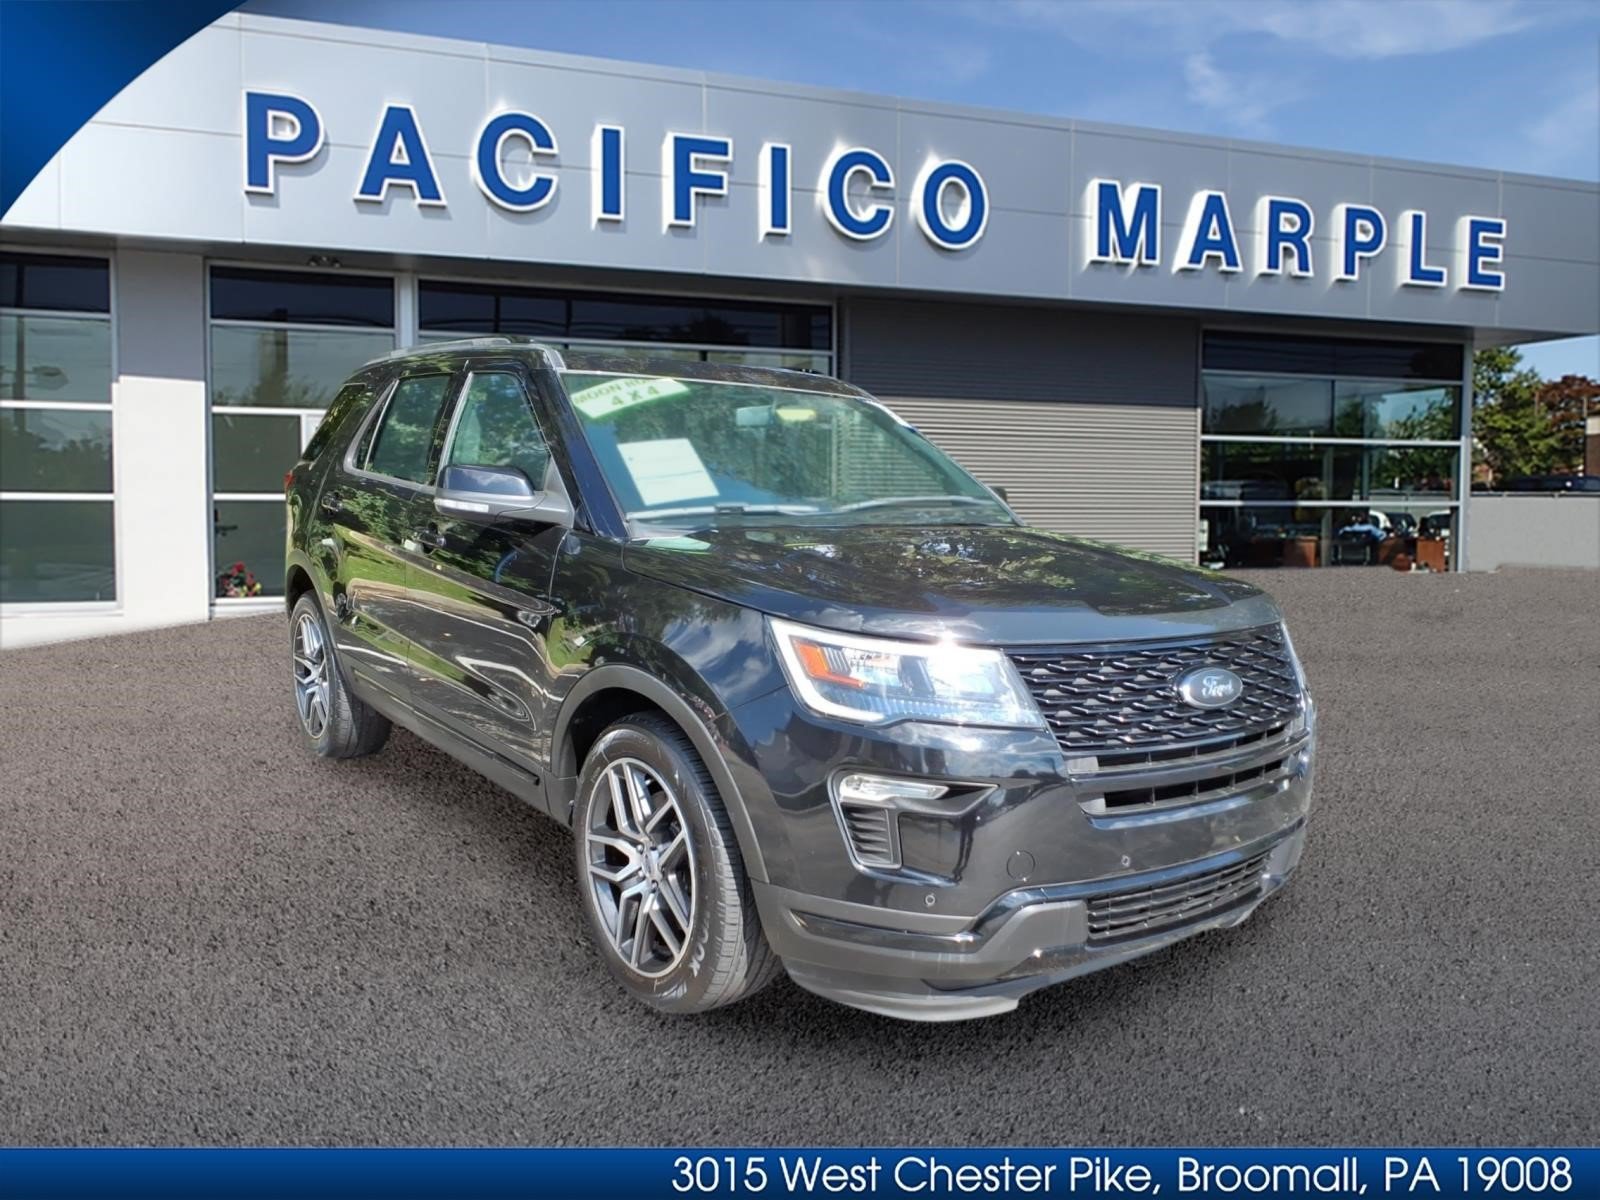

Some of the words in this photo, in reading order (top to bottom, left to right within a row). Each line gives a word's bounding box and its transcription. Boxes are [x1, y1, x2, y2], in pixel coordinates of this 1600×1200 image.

[243, 90, 989, 250] PACIFICO
[1087, 179, 1506, 291] MARPLE
[1201, 675, 1234, 698] Ford
